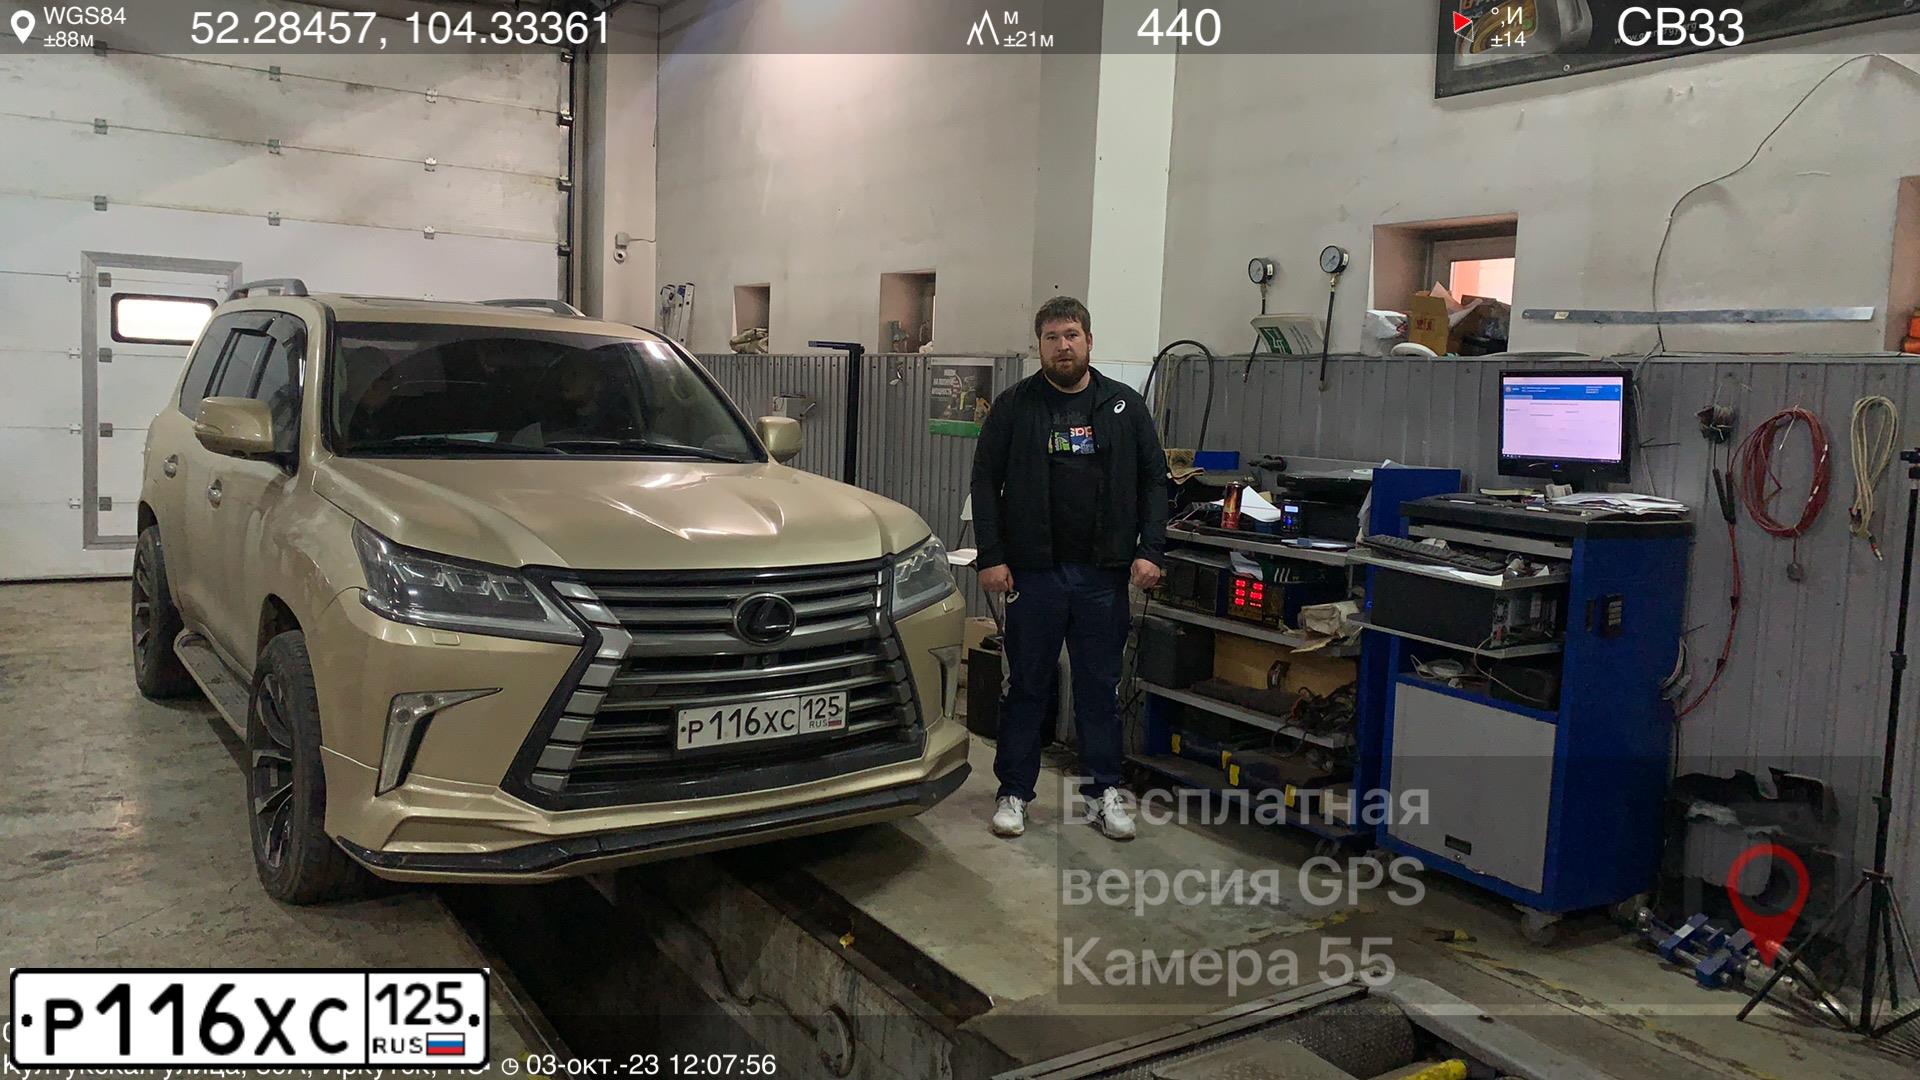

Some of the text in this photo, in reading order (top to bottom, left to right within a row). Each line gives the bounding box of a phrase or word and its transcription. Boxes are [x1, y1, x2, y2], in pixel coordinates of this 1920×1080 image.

[688, 696, 840, 743] Р116ХС 125
[809, 720, 827, 728] RUS
